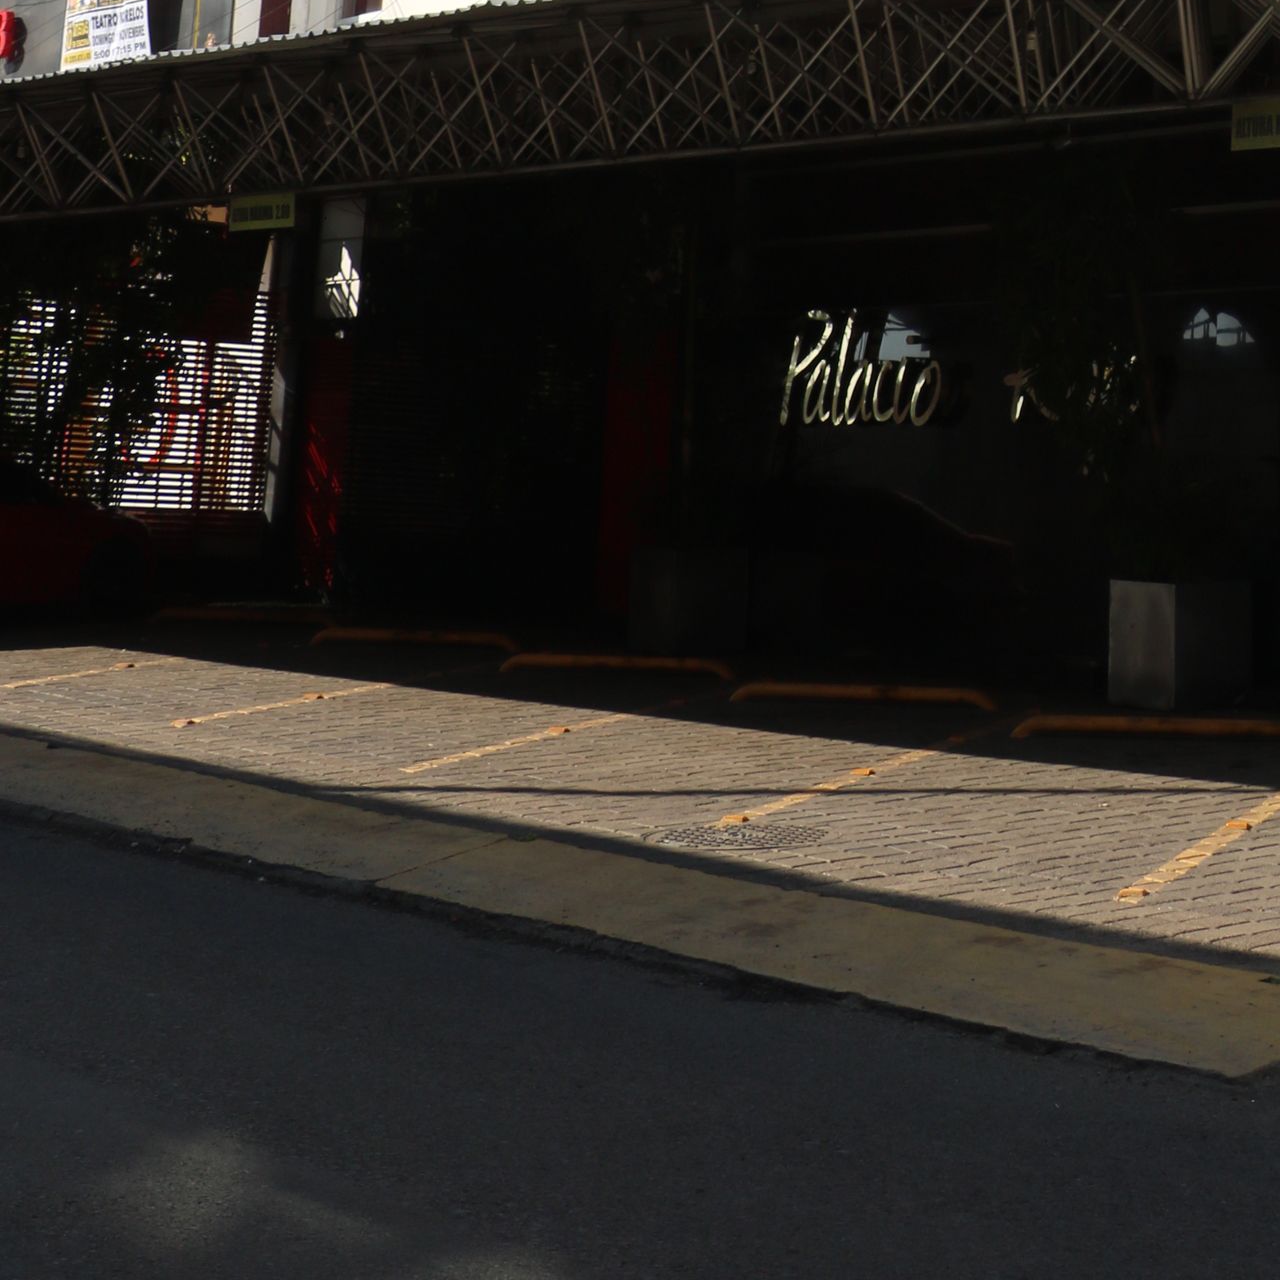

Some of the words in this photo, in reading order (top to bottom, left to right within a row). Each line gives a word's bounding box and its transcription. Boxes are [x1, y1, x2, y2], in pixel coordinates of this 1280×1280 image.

[91, 13, 118, 29] TEATRO
[134, 41, 146, 51] PM
[780, 306, 943, 427] Palacio
